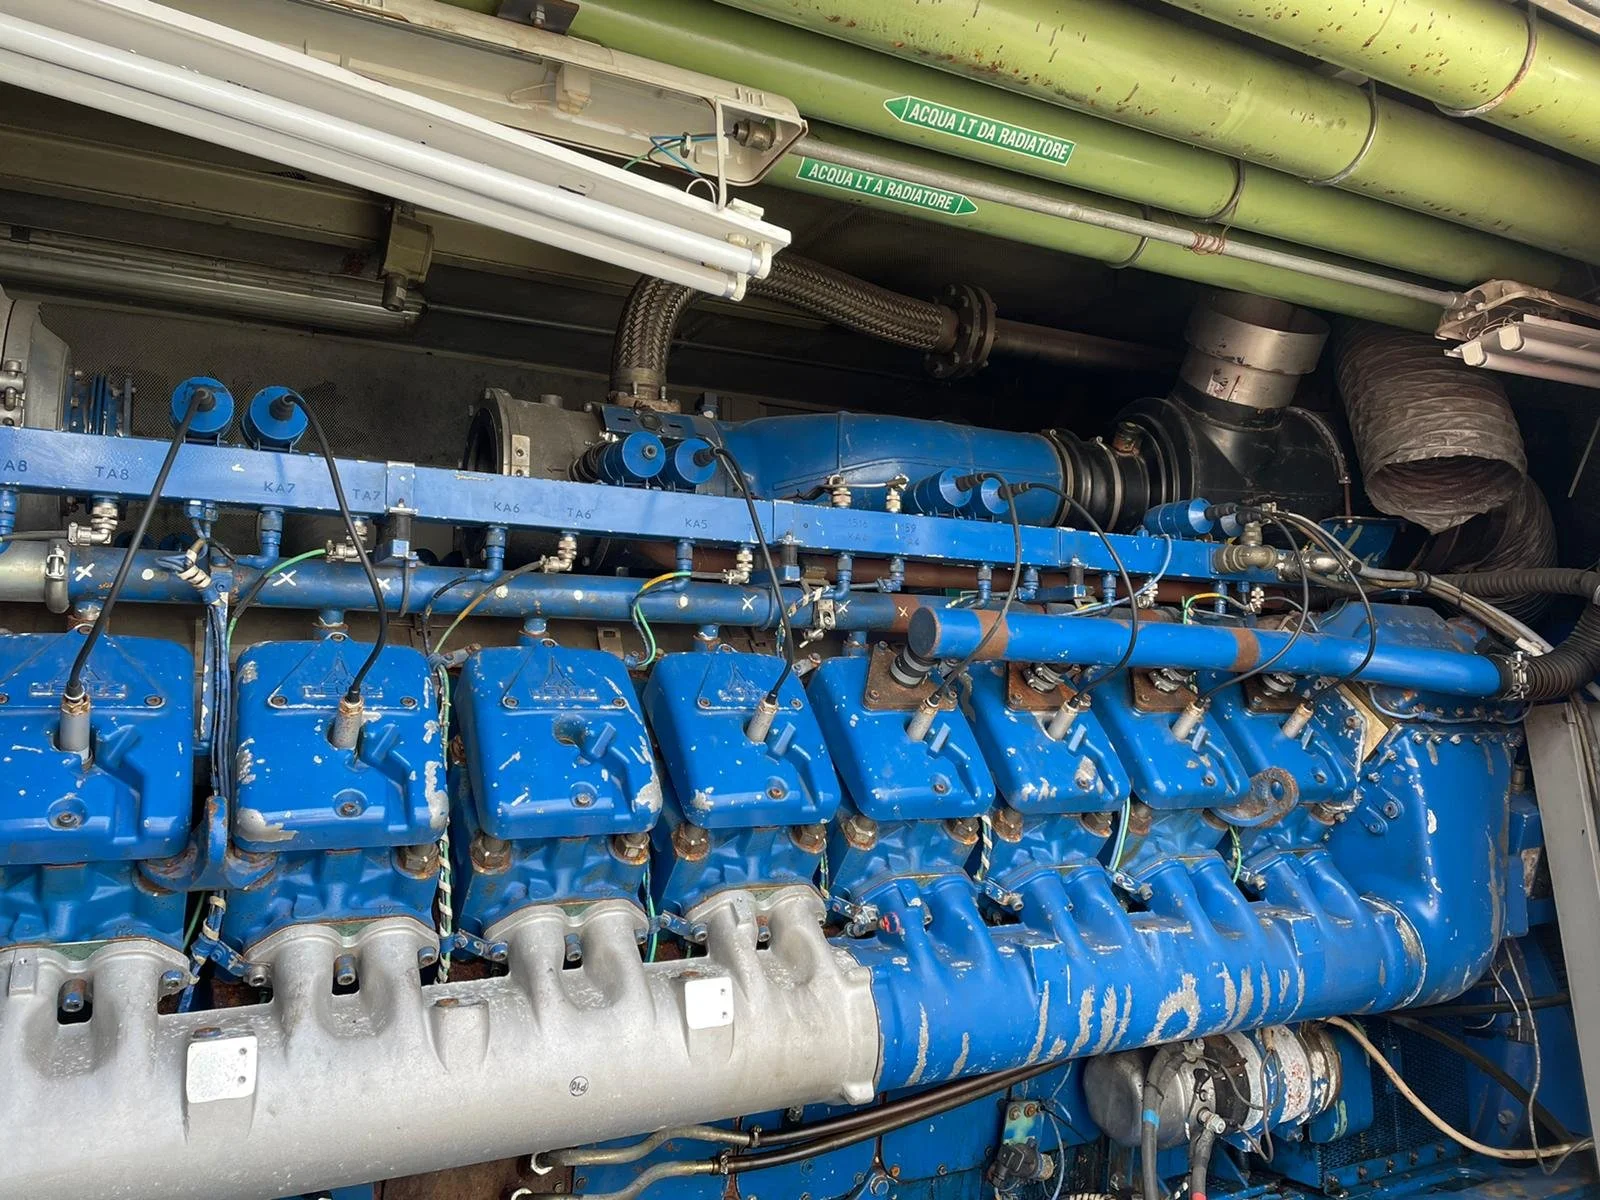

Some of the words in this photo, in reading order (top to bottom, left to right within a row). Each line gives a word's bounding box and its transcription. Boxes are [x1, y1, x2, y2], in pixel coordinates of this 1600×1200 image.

[908, 103, 956, 130] ACQUA
[958, 116, 978, 135] LT
[977, 122, 997, 142] DA
[997, 127, 1070, 160] RADIATORE
[808, 163, 854, 185] ACQUA
[855, 174, 874, 190] LT
[873, 179, 882, 193] A
[884, 181, 955, 210] RADIATORE
[94, 465, 130, 481] TA8
[264, 480, 296, 495] KA7
[351, 488, 381, 501] TA7
[493, 501, 520, 514] KA6
[567, 507, 592, 520] TA6
[684, 518, 708, 530] KA5
